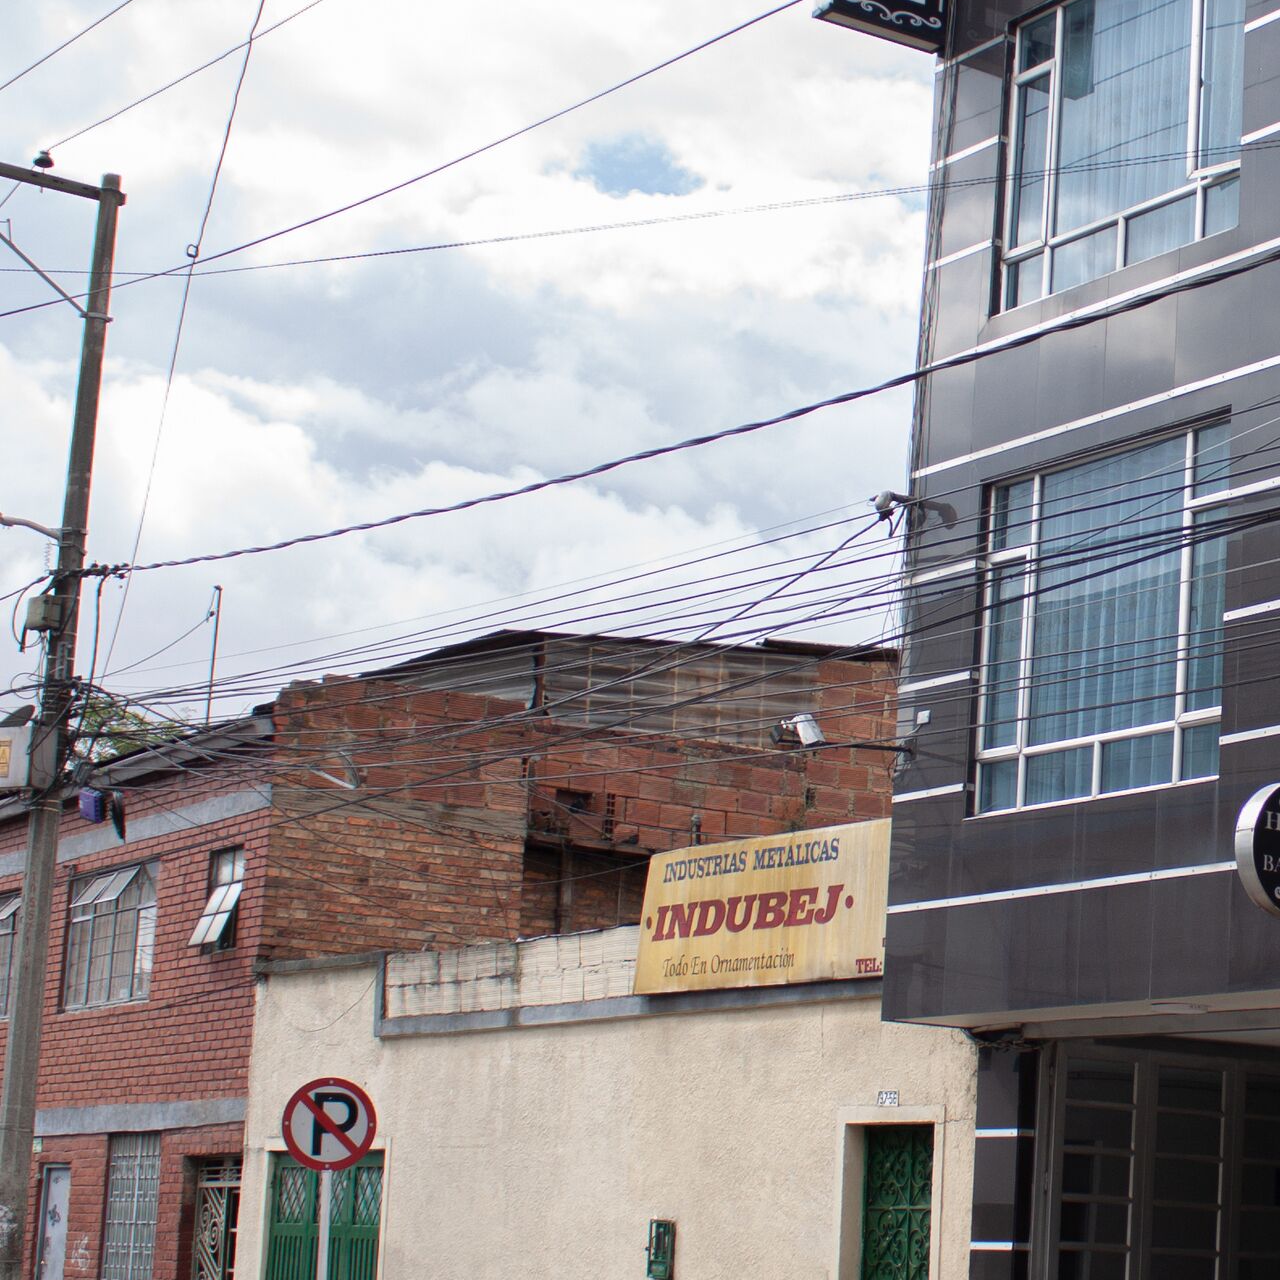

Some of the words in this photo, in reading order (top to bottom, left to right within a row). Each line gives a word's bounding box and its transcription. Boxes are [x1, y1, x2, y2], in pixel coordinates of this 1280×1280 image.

[663, 851, 747, 883] INDUSTRIAS
[753, 838, 840, 870] METALICAS
[663, 956, 689, 977] Todo
[691, 955, 707, 975] En
[711, 947, 794, 974] Ornamentación
[855, 957, 882, 974] TEL:
[311, 1091, 358, 1156] P
